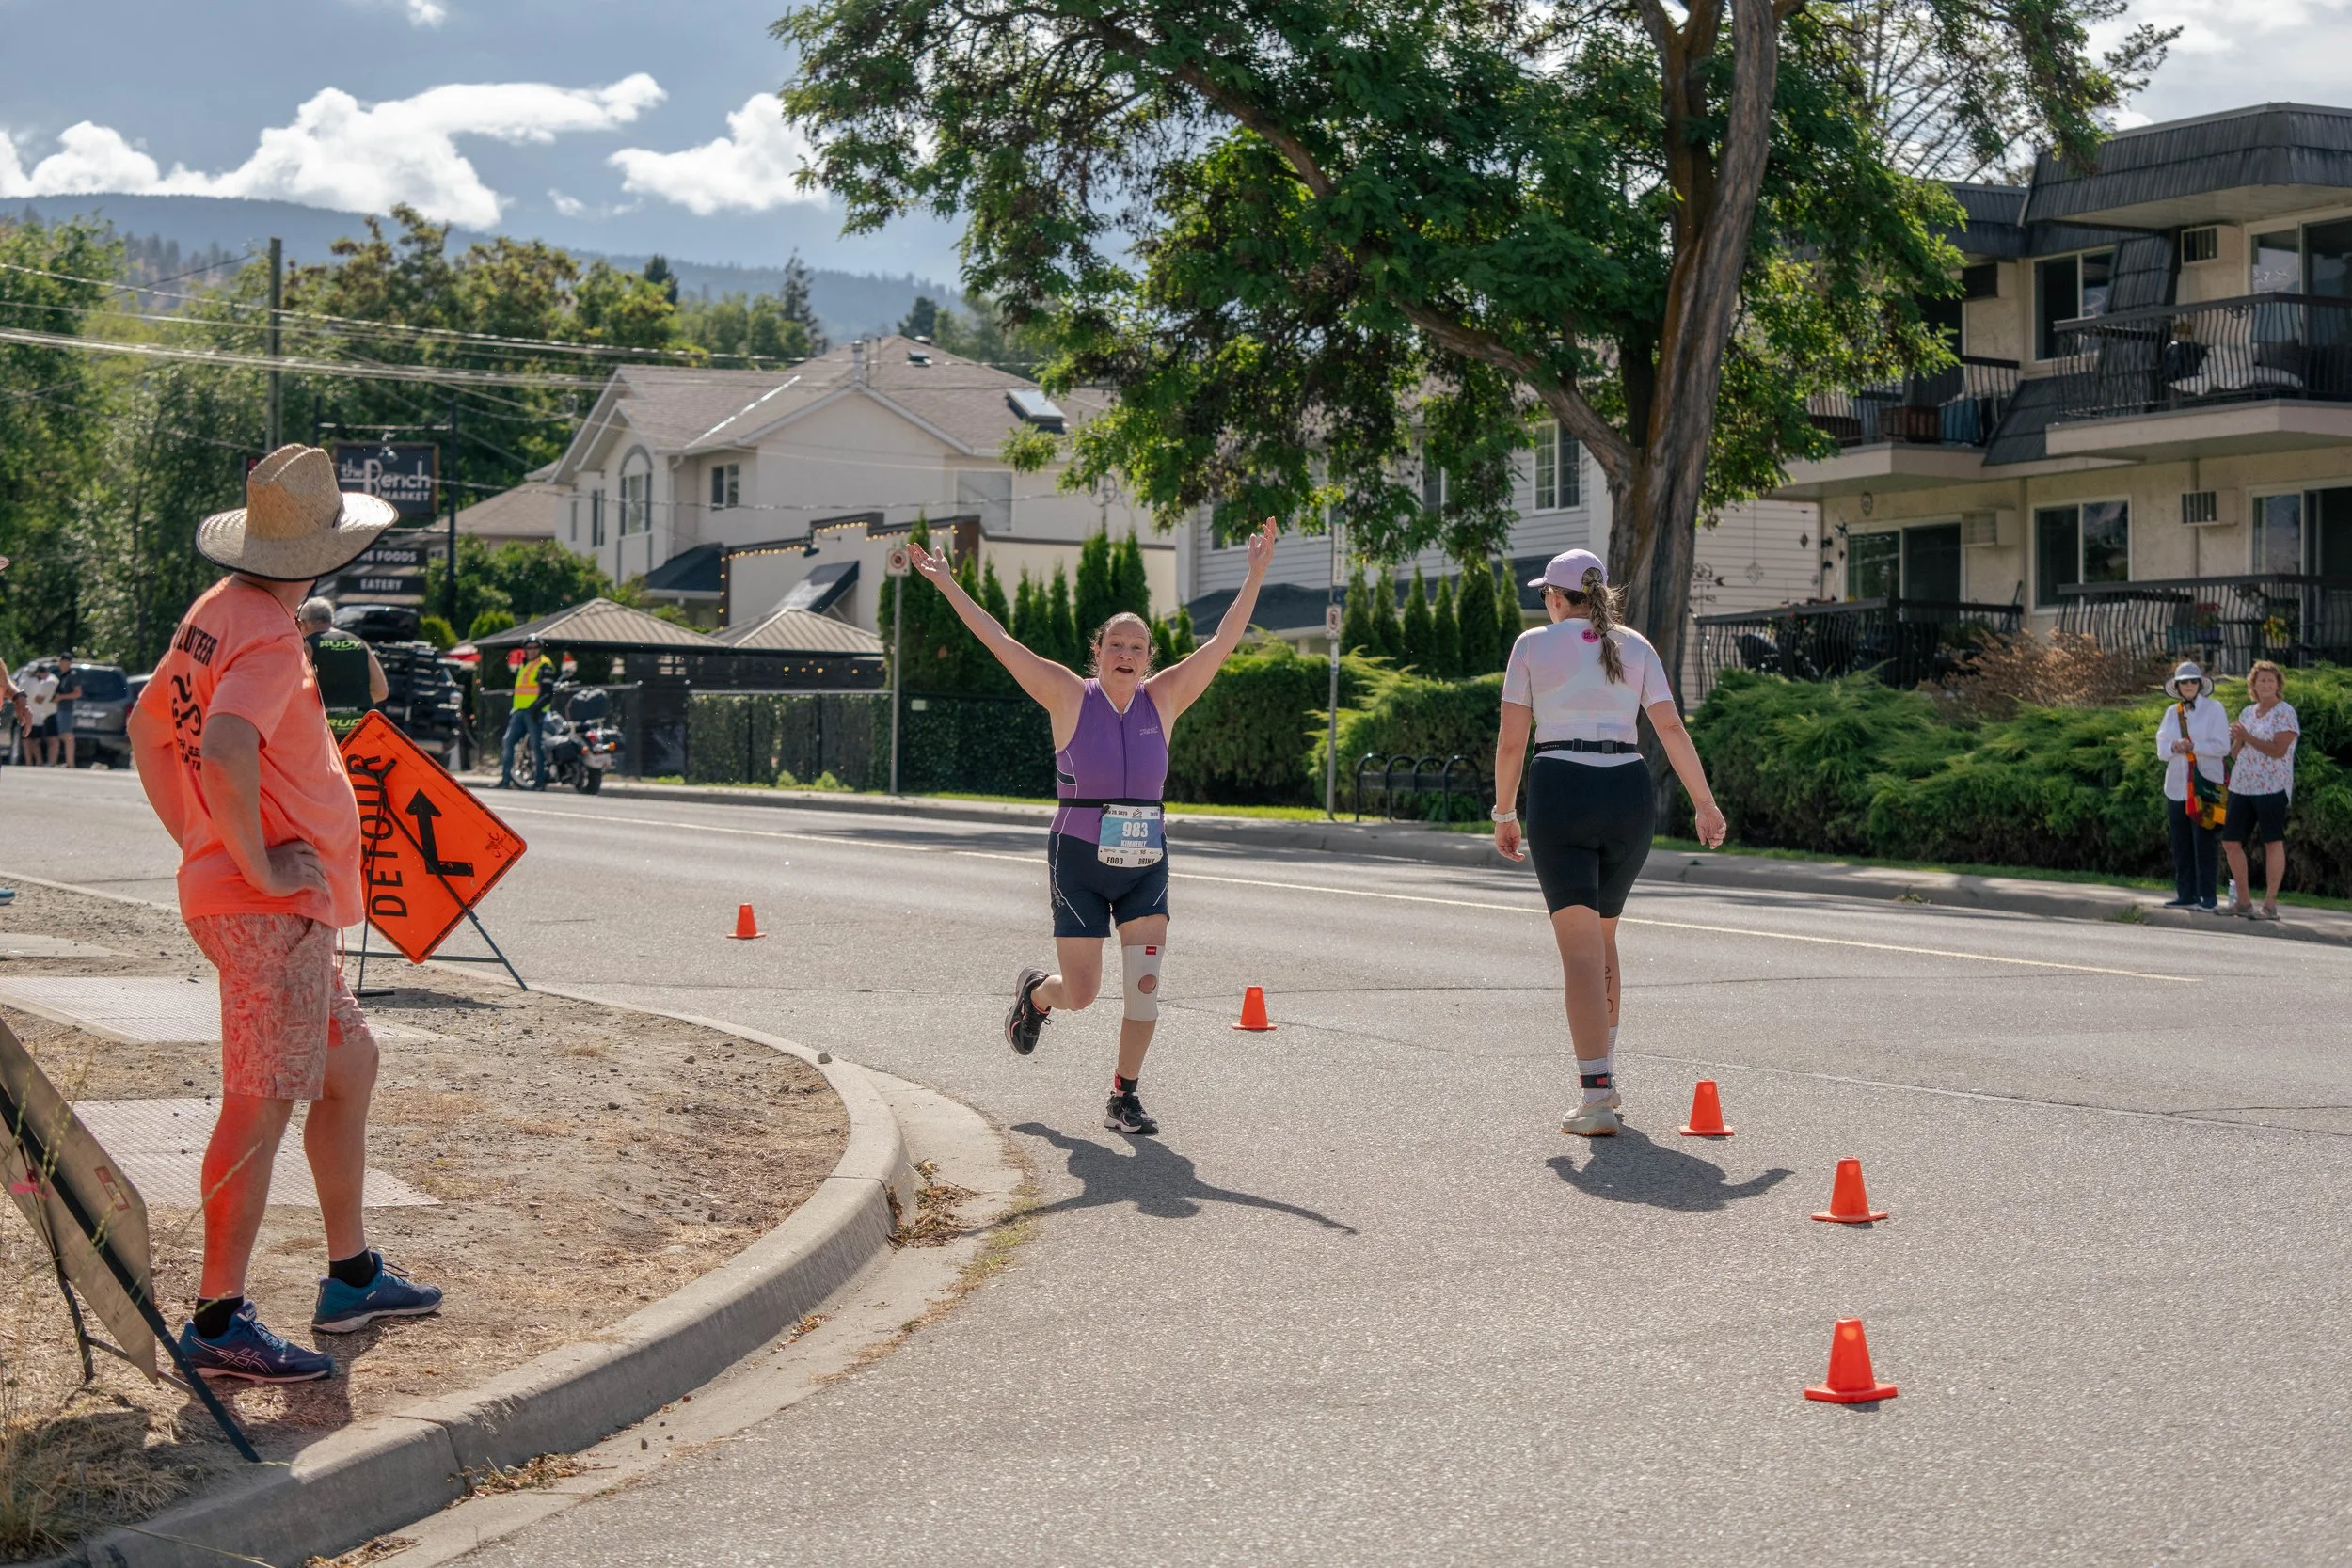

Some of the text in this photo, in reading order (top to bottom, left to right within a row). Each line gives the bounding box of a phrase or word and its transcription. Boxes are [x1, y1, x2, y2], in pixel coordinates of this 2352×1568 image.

[363, 459, 431, 498] Bench
[380, 490, 430, 501] MARKET
[376, 550, 417, 562] FOODS
[360, 578, 403, 591] EATERY
[346, 753, 408, 917] DETOUR
[1122, 821, 1149, 837] 983
